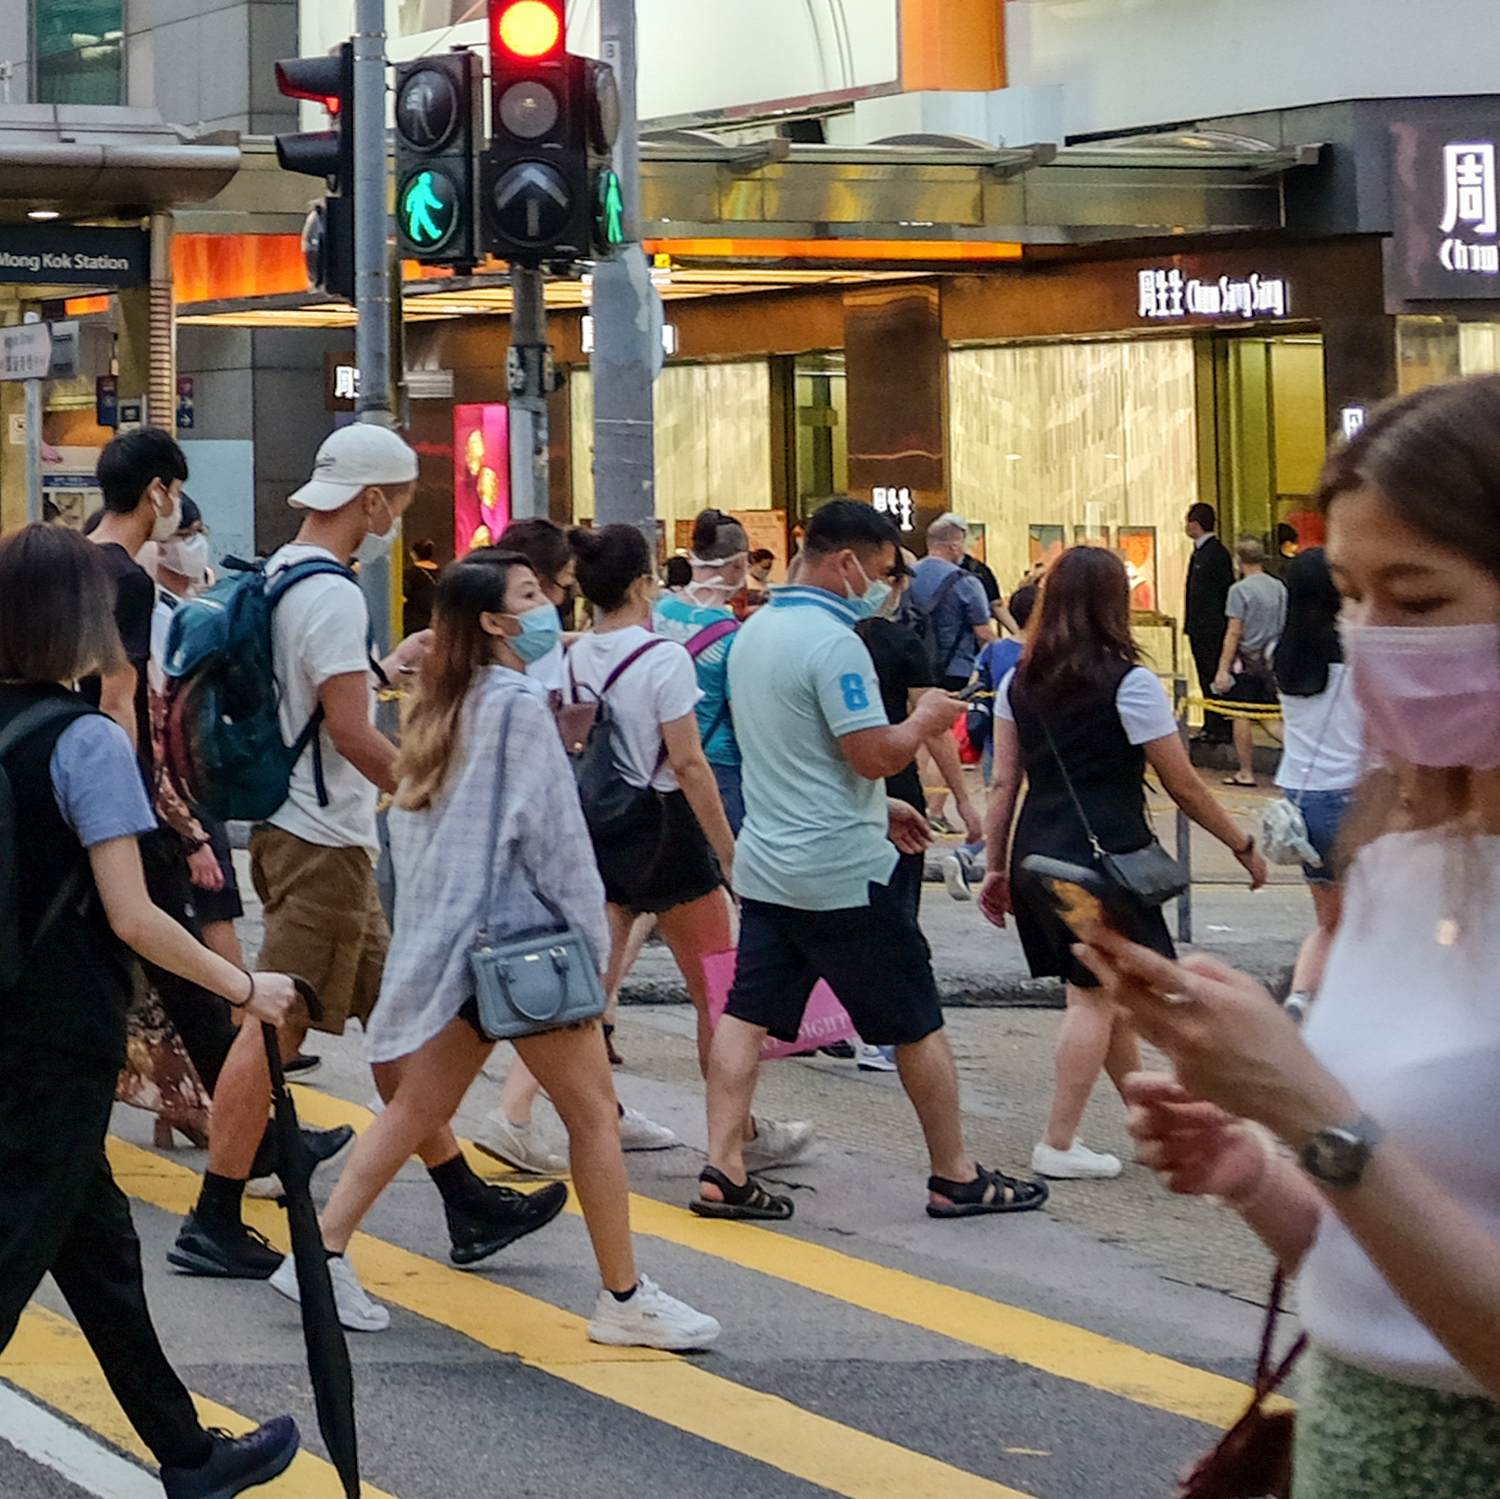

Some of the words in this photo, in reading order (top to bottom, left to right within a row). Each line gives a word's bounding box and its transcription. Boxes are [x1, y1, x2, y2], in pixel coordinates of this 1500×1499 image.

[1438, 144, 1497, 233] 周
[41, 252, 74, 270] Kok
[74, 253, 130, 271] Station
[840, 672, 870, 712] 8
